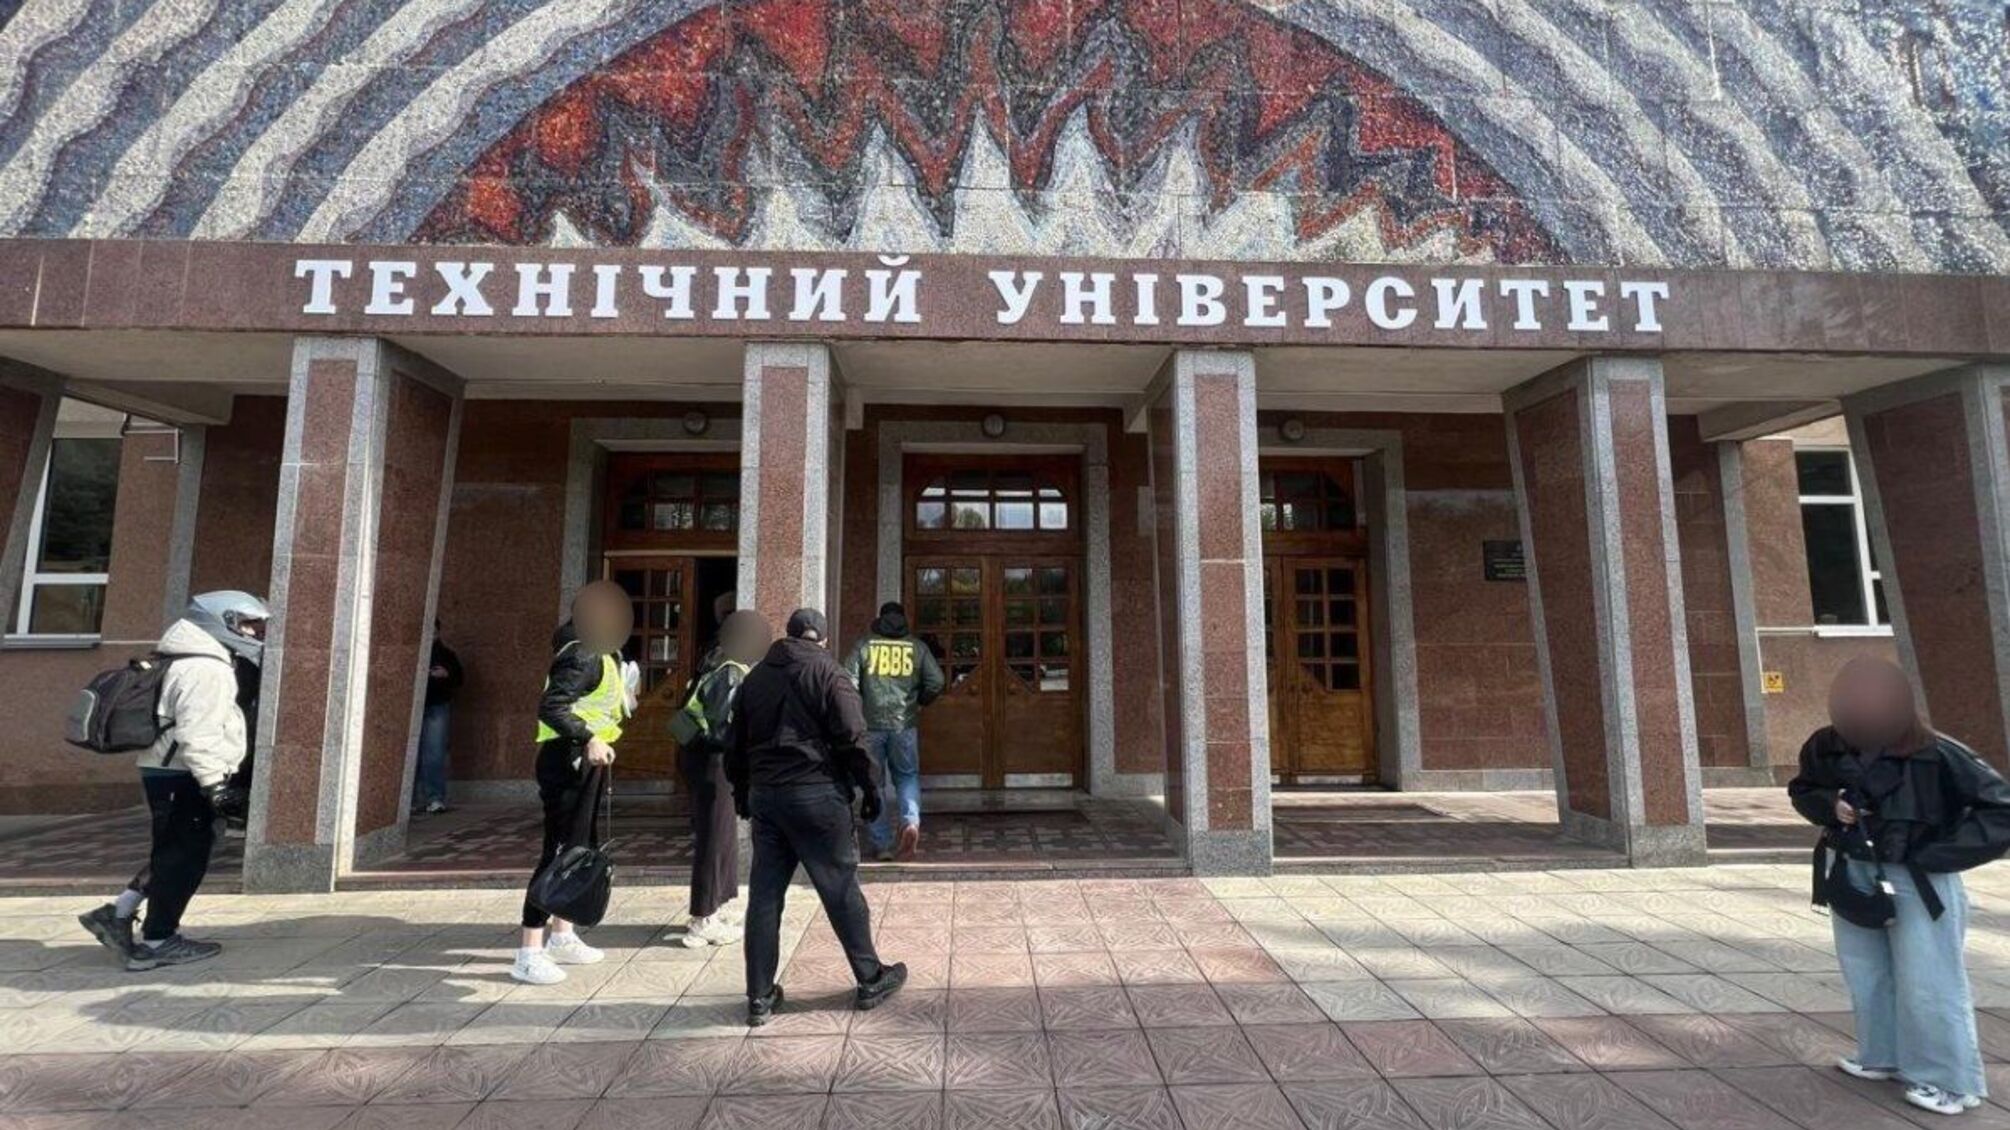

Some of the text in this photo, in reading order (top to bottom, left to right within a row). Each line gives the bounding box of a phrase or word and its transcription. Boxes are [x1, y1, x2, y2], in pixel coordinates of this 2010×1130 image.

[294, 254, 1671, 332] ТЕХНІЧНИЙ УНІВЕРСИТЕТ
[866, 645, 914, 676] УВВБ
